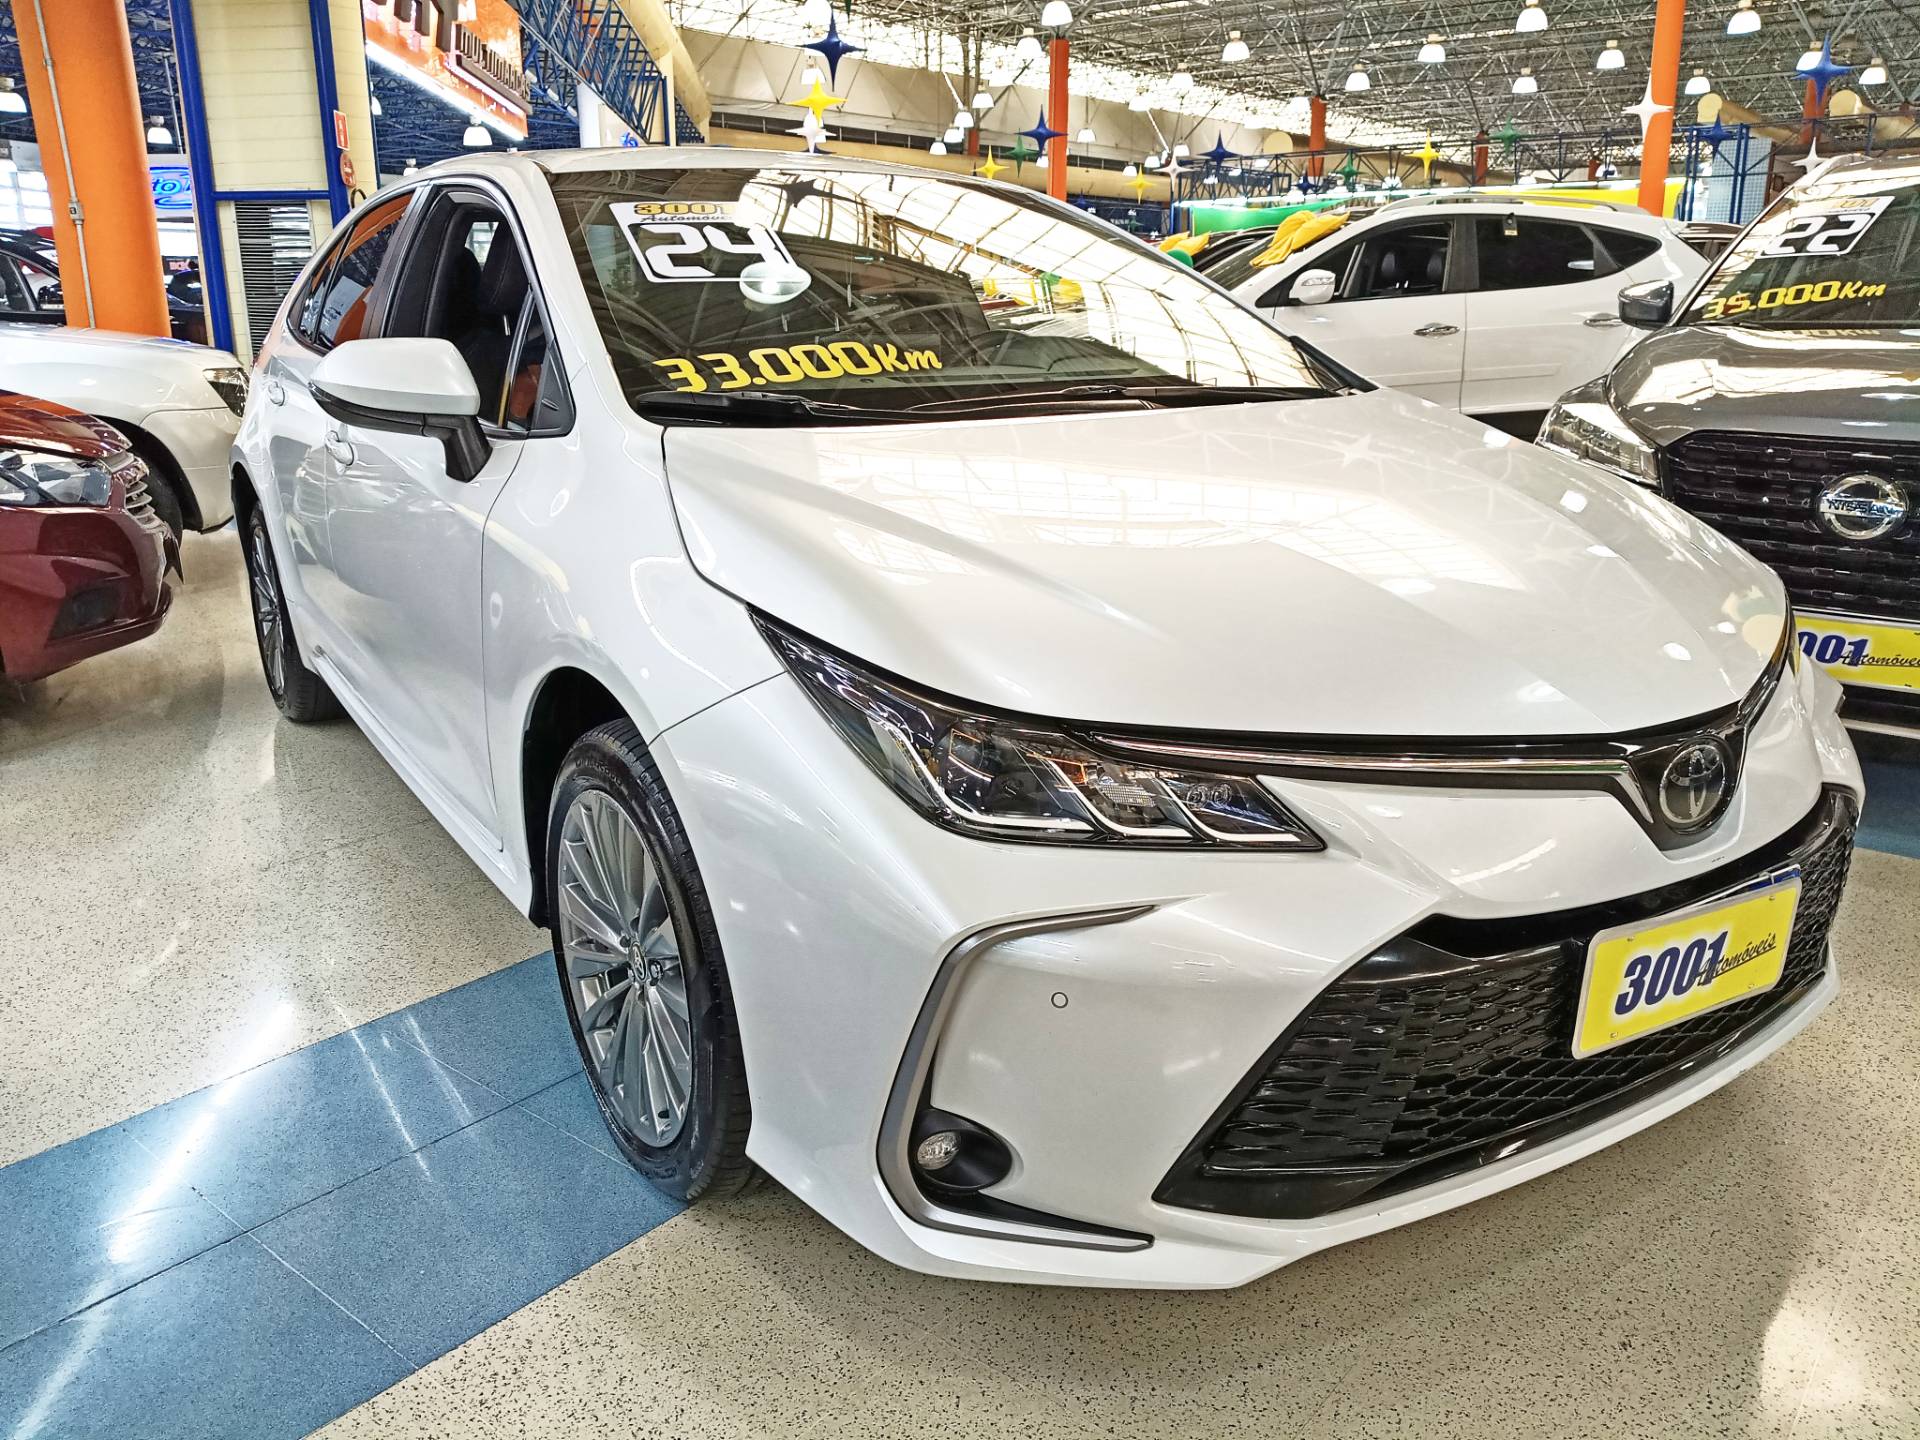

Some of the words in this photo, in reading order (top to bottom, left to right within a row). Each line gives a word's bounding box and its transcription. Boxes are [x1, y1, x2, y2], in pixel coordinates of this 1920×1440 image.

[640, 223, 787, 277] 24
[1764, 213, 1873, 254] 22
[652, 341, 942, 391] 33.000Km
[1614, 931, 1728, 1015] 3001
